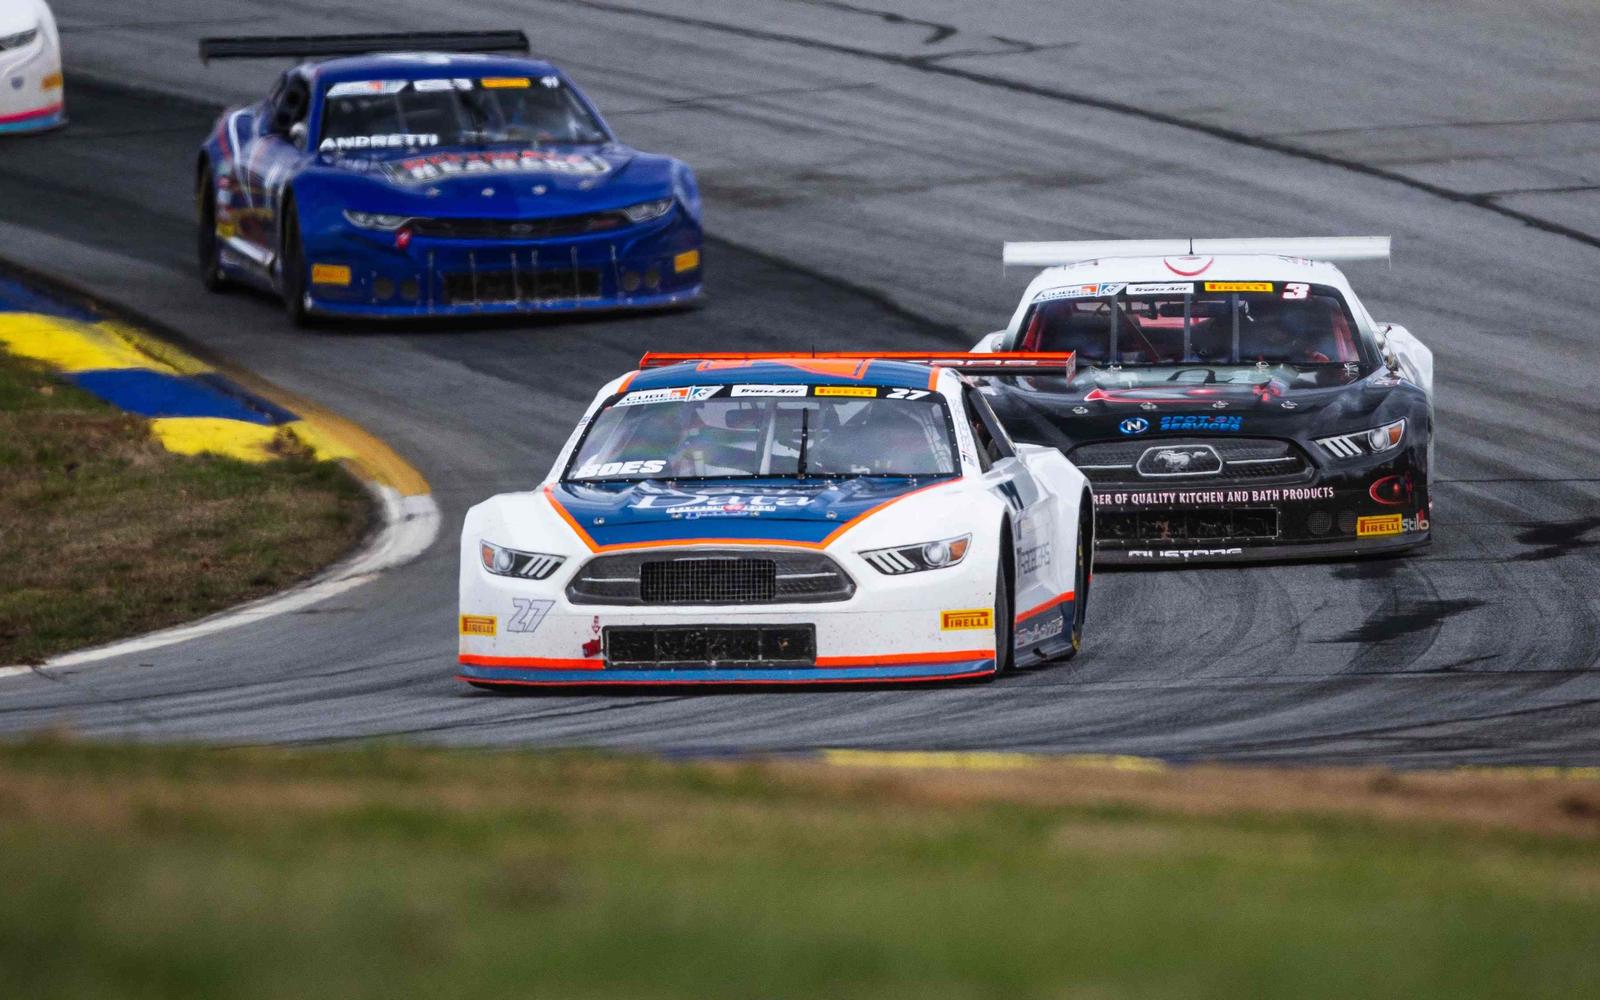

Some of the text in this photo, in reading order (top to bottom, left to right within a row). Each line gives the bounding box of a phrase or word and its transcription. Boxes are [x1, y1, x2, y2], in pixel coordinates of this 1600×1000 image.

[320, 133, 439, 150] ANDRETTI
[1281, 282, 1311, 300] 3
[886, 388, 932, 401] 27
[1160, 423, 1241, 432] SERVICES
[574, 459, 668, 480] BOES
[1114, 493, 1129, 504] OF
[1131, 492, 1176, 505] QUALITY
[1179, 490, 1224, 504] KITCHEN
[1227, 490, 1249, 503] AND
[1252, 489, 1280, 502] BATH
[1282, 486, 1335, 501] PRODUCTS
[1360, 516, 1400, 533] PIRELLI
[462, 615, 495, 633] PIRELLI
[507, 597, 556, 633] 27
[943, 611, 989, 629] PIRELLI
